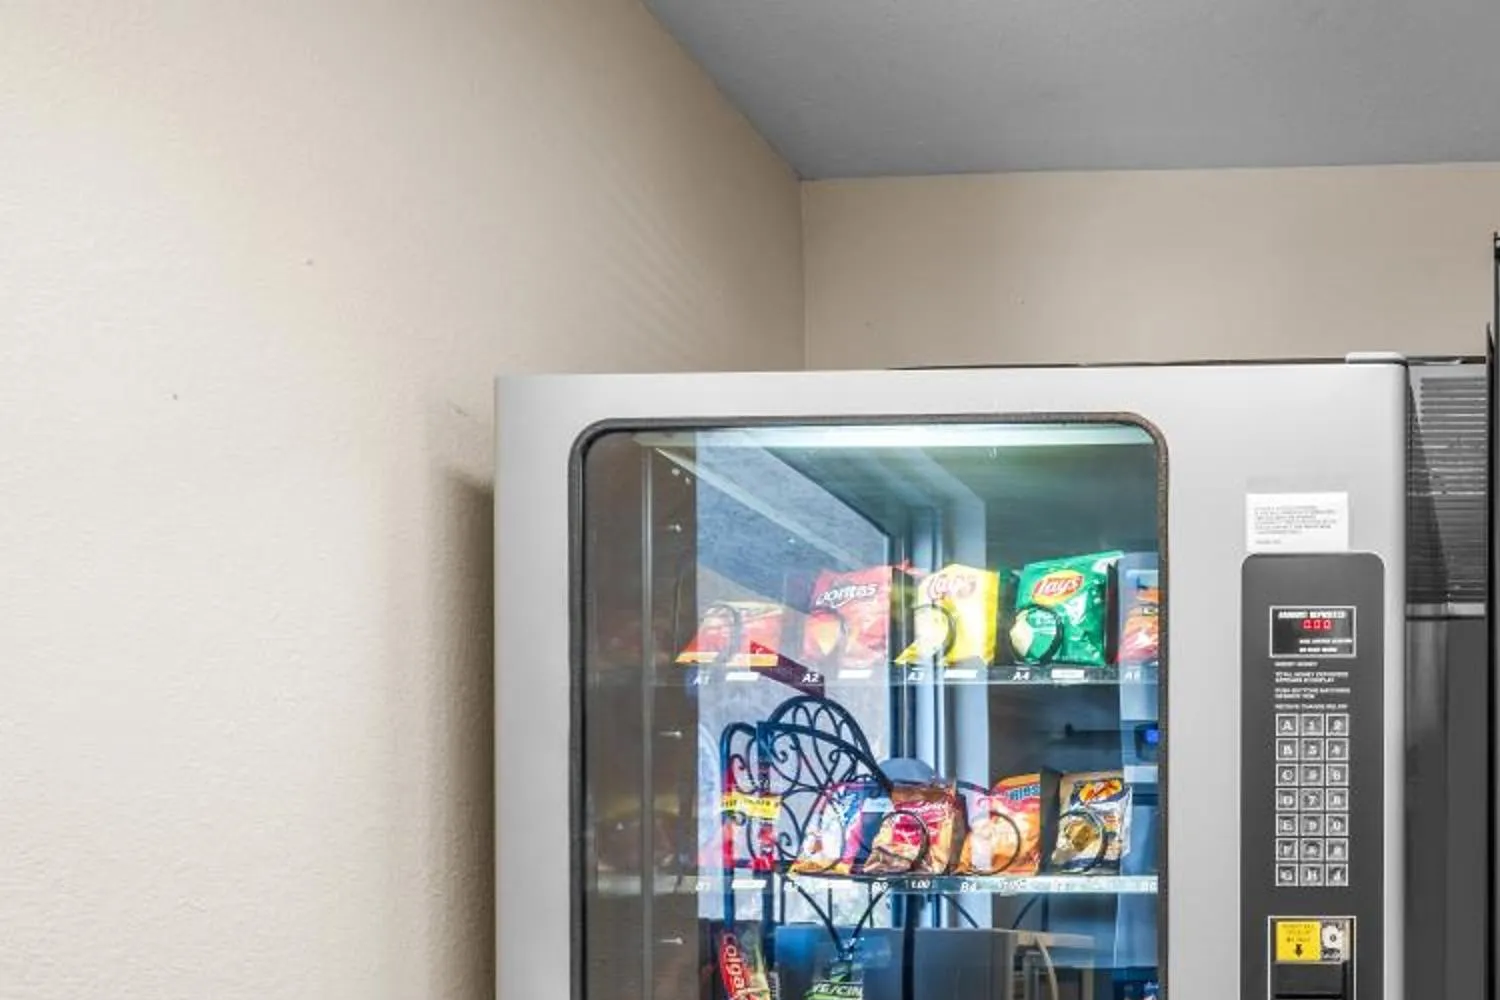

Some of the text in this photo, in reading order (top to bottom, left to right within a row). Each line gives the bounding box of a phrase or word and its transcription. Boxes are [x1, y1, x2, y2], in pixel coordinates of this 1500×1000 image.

[815, 583, 878, 608] Doritos
[1036, 577, 1082, 598] Lay's
[801, 673, 819, 683] A2
[1012, 670, 1031, 681] A4
